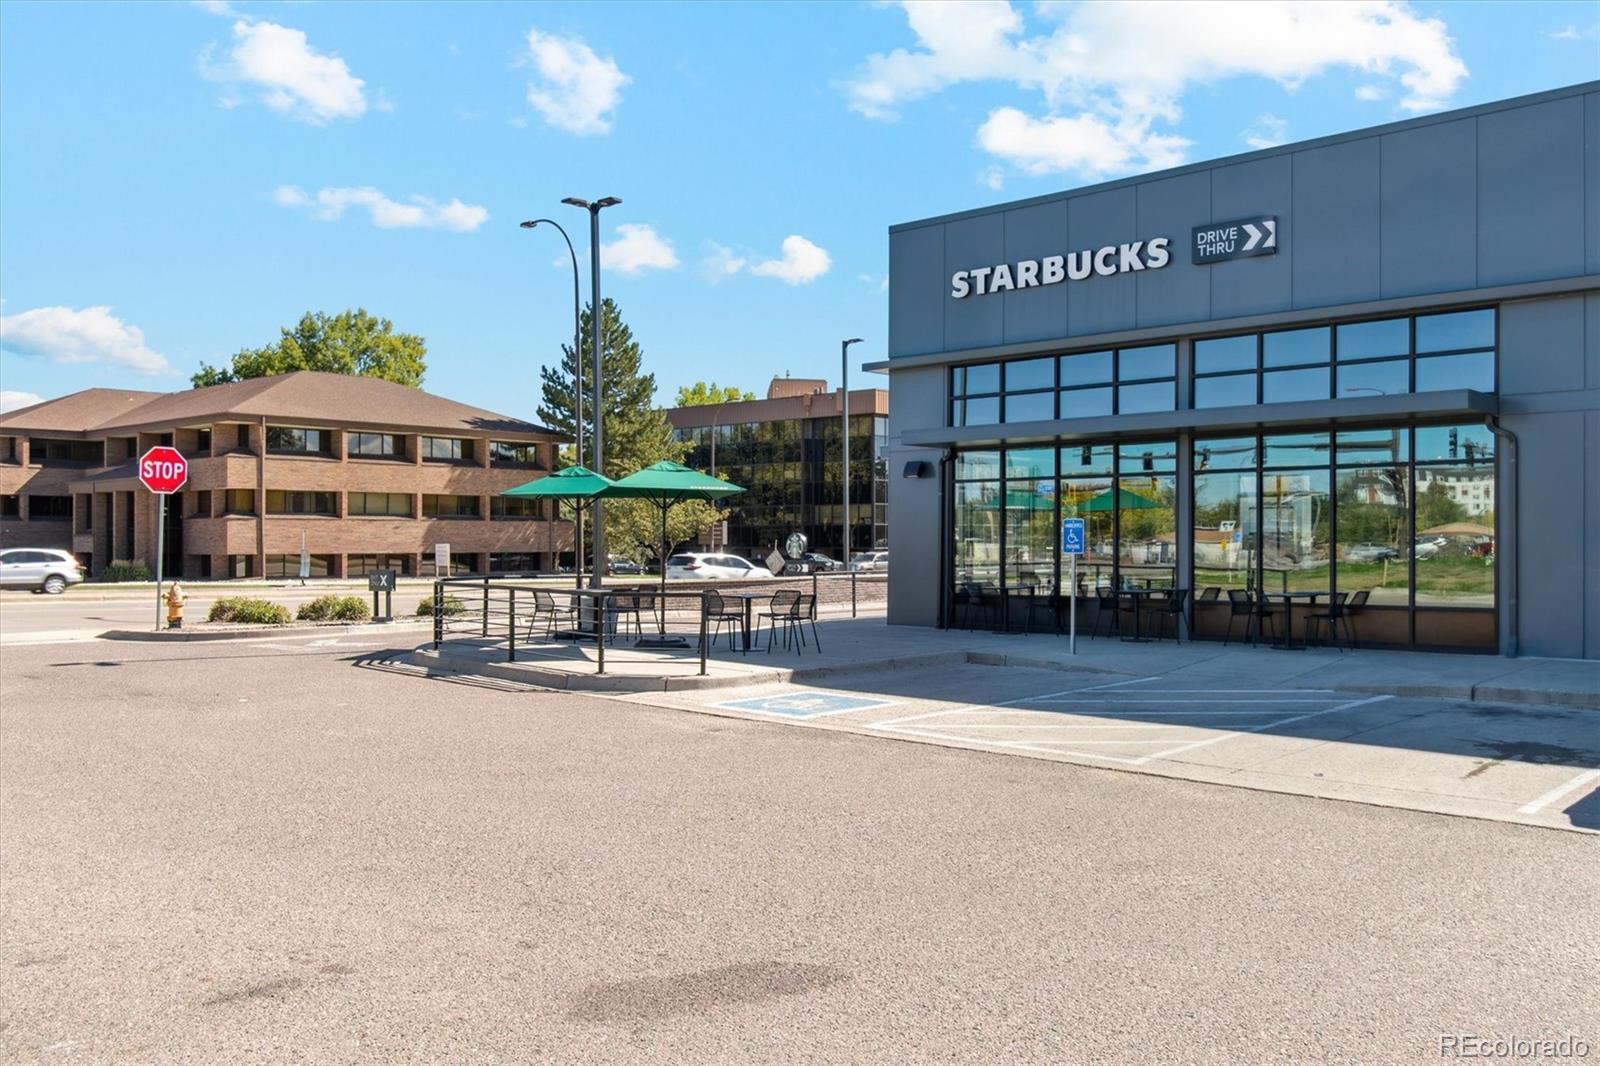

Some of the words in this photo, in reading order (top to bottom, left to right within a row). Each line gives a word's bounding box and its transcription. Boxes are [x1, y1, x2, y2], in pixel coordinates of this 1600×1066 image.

[1197, 227, 1238, 245] DRIVE
[1197, 240, 1235, 257] THRU
[951, 237, 1171, 299] STARBUCKS
[143, 460, 184, 480] STOP
